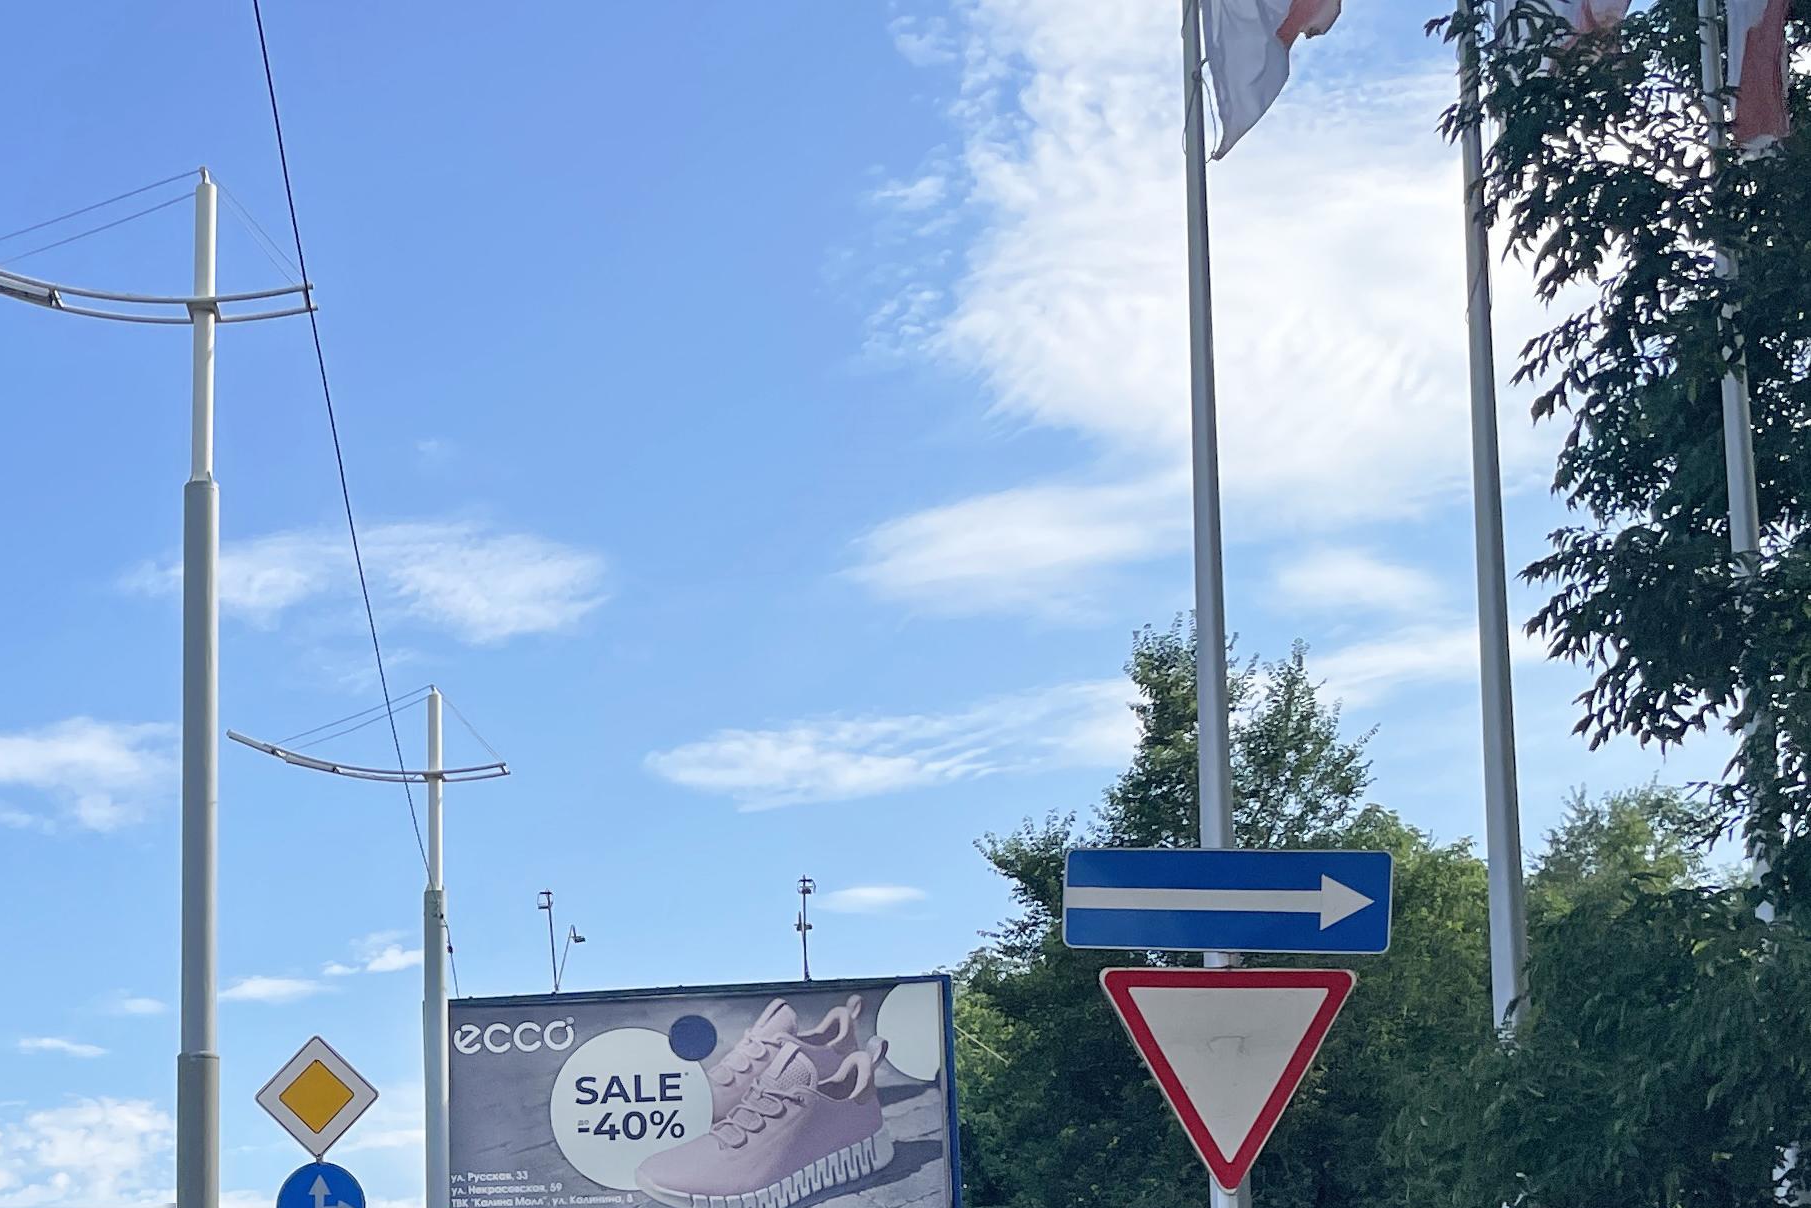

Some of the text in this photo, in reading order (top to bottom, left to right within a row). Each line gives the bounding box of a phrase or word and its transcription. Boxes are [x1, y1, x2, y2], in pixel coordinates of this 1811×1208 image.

[453, 1016, 574, 1055] ecco
[575, 1073, 683, 1105] SALE
[578, 1110, 685, 1141] -40%
[451, 1170, 529, 1184] ул. Русская, 33
[451, 1187, 466, 1197] ул.
[468, 1184, 548, 1195] Некрасовская,
